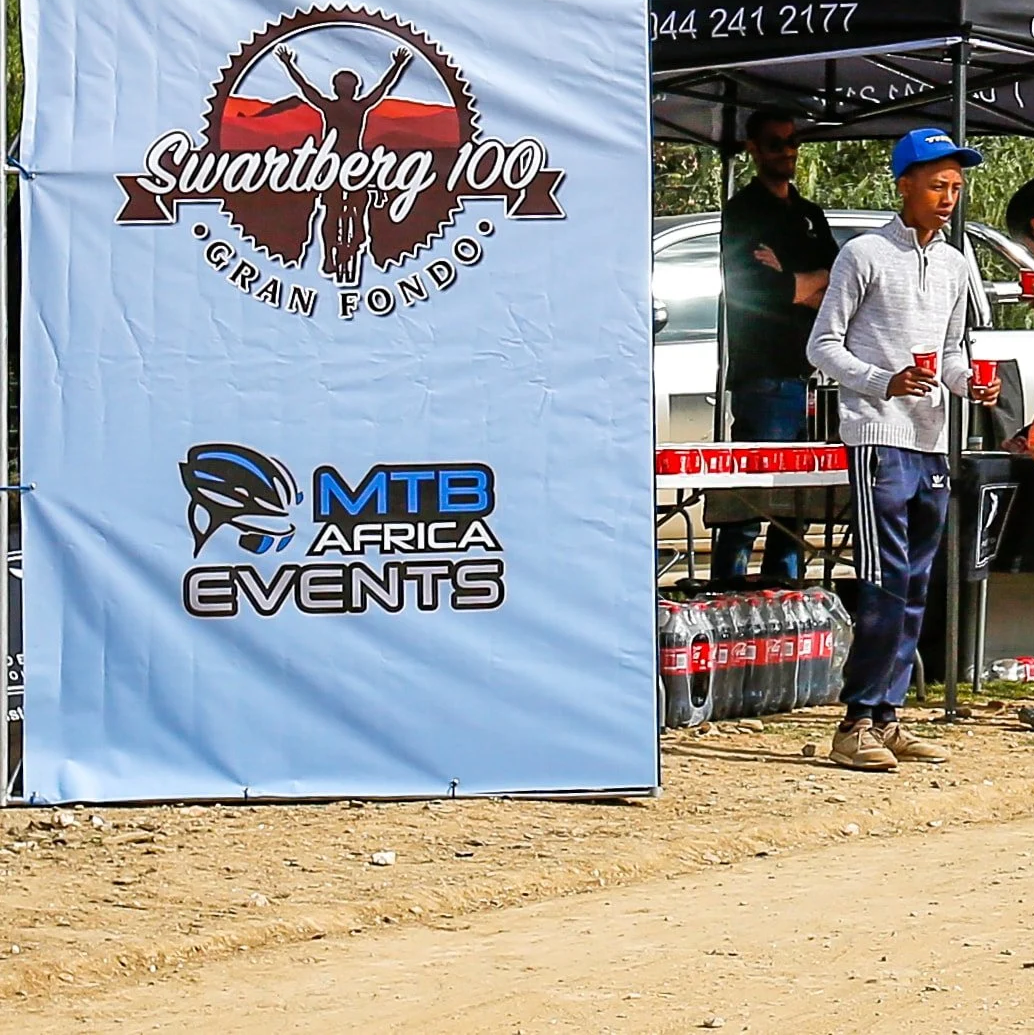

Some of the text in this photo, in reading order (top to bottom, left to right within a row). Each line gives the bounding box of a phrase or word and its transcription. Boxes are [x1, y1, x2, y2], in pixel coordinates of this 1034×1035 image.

[709, 6, 764, 38] 241
[779, 2, 858, 35] 2177
[146, 129, 546, 223] Swartberg 100
[204, 234, 483, 319] GRAN FONDO
[317, 469, 489, 515] MTB
[313, 520, 495, 552] AFRICA
[186, 565, 501, 610] EVENTS
